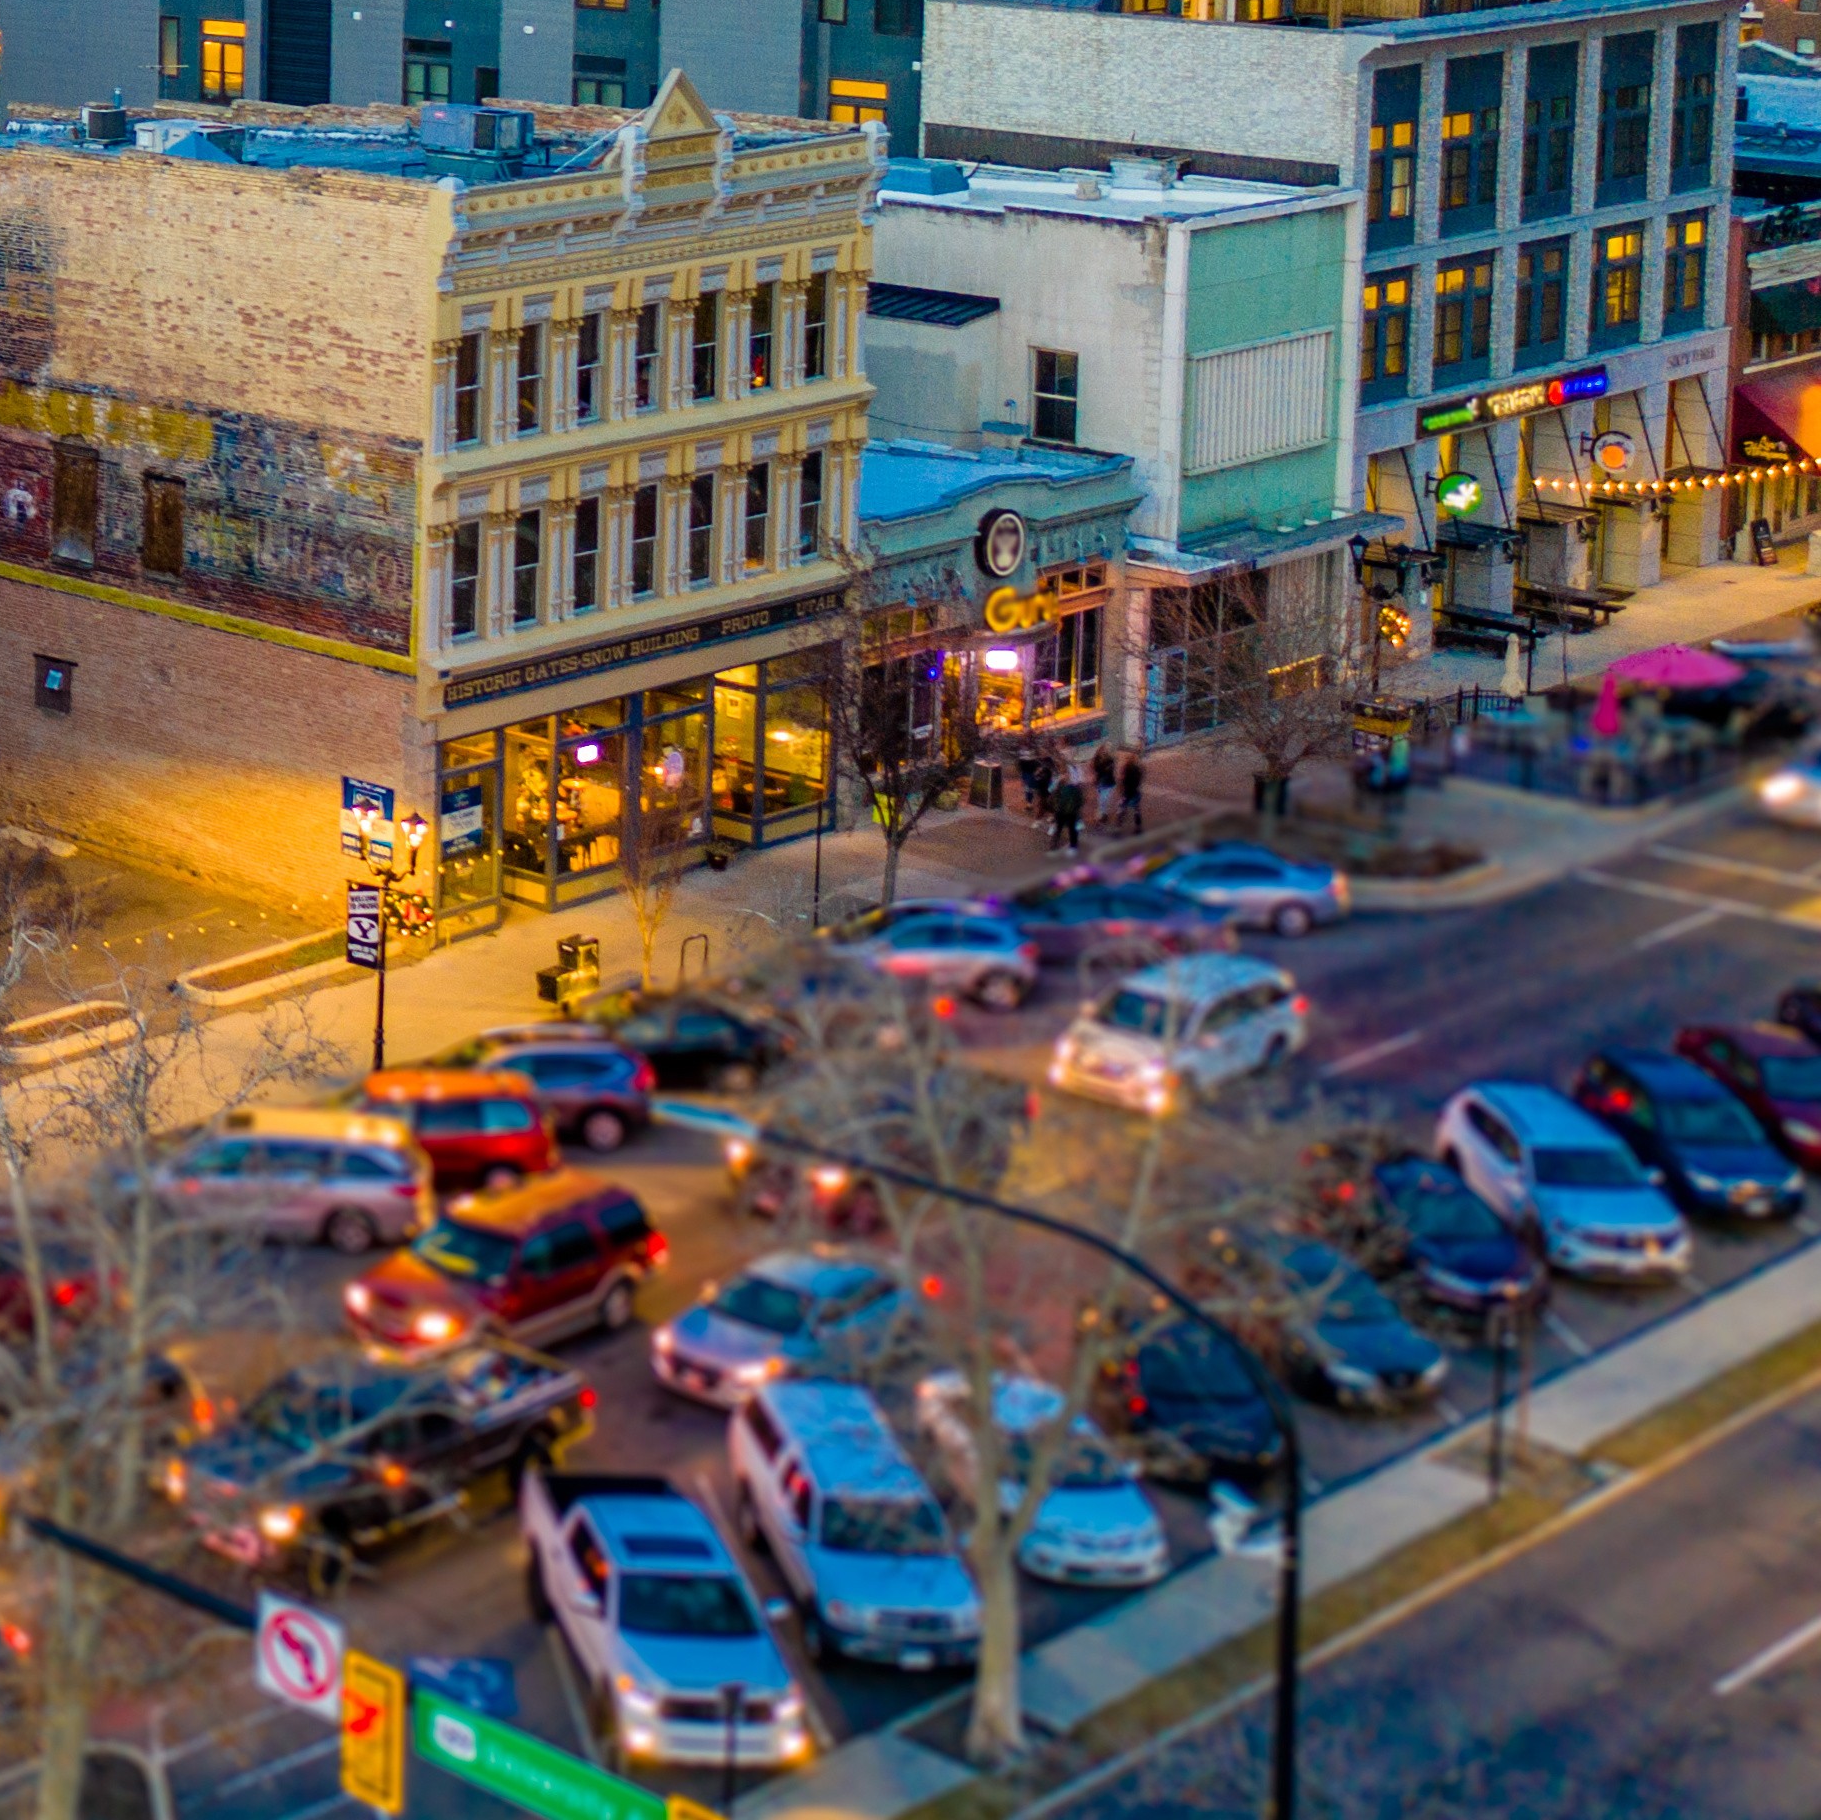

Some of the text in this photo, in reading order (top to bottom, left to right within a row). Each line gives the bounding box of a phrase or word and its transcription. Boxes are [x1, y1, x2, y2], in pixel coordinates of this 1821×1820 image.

[445, 670, 520, 703] HISTORIC
[630, 626, 701, 658] BUILDING
[720, 610, 771, 637] PROVO
[795, 593, 839, 618] UTAH
